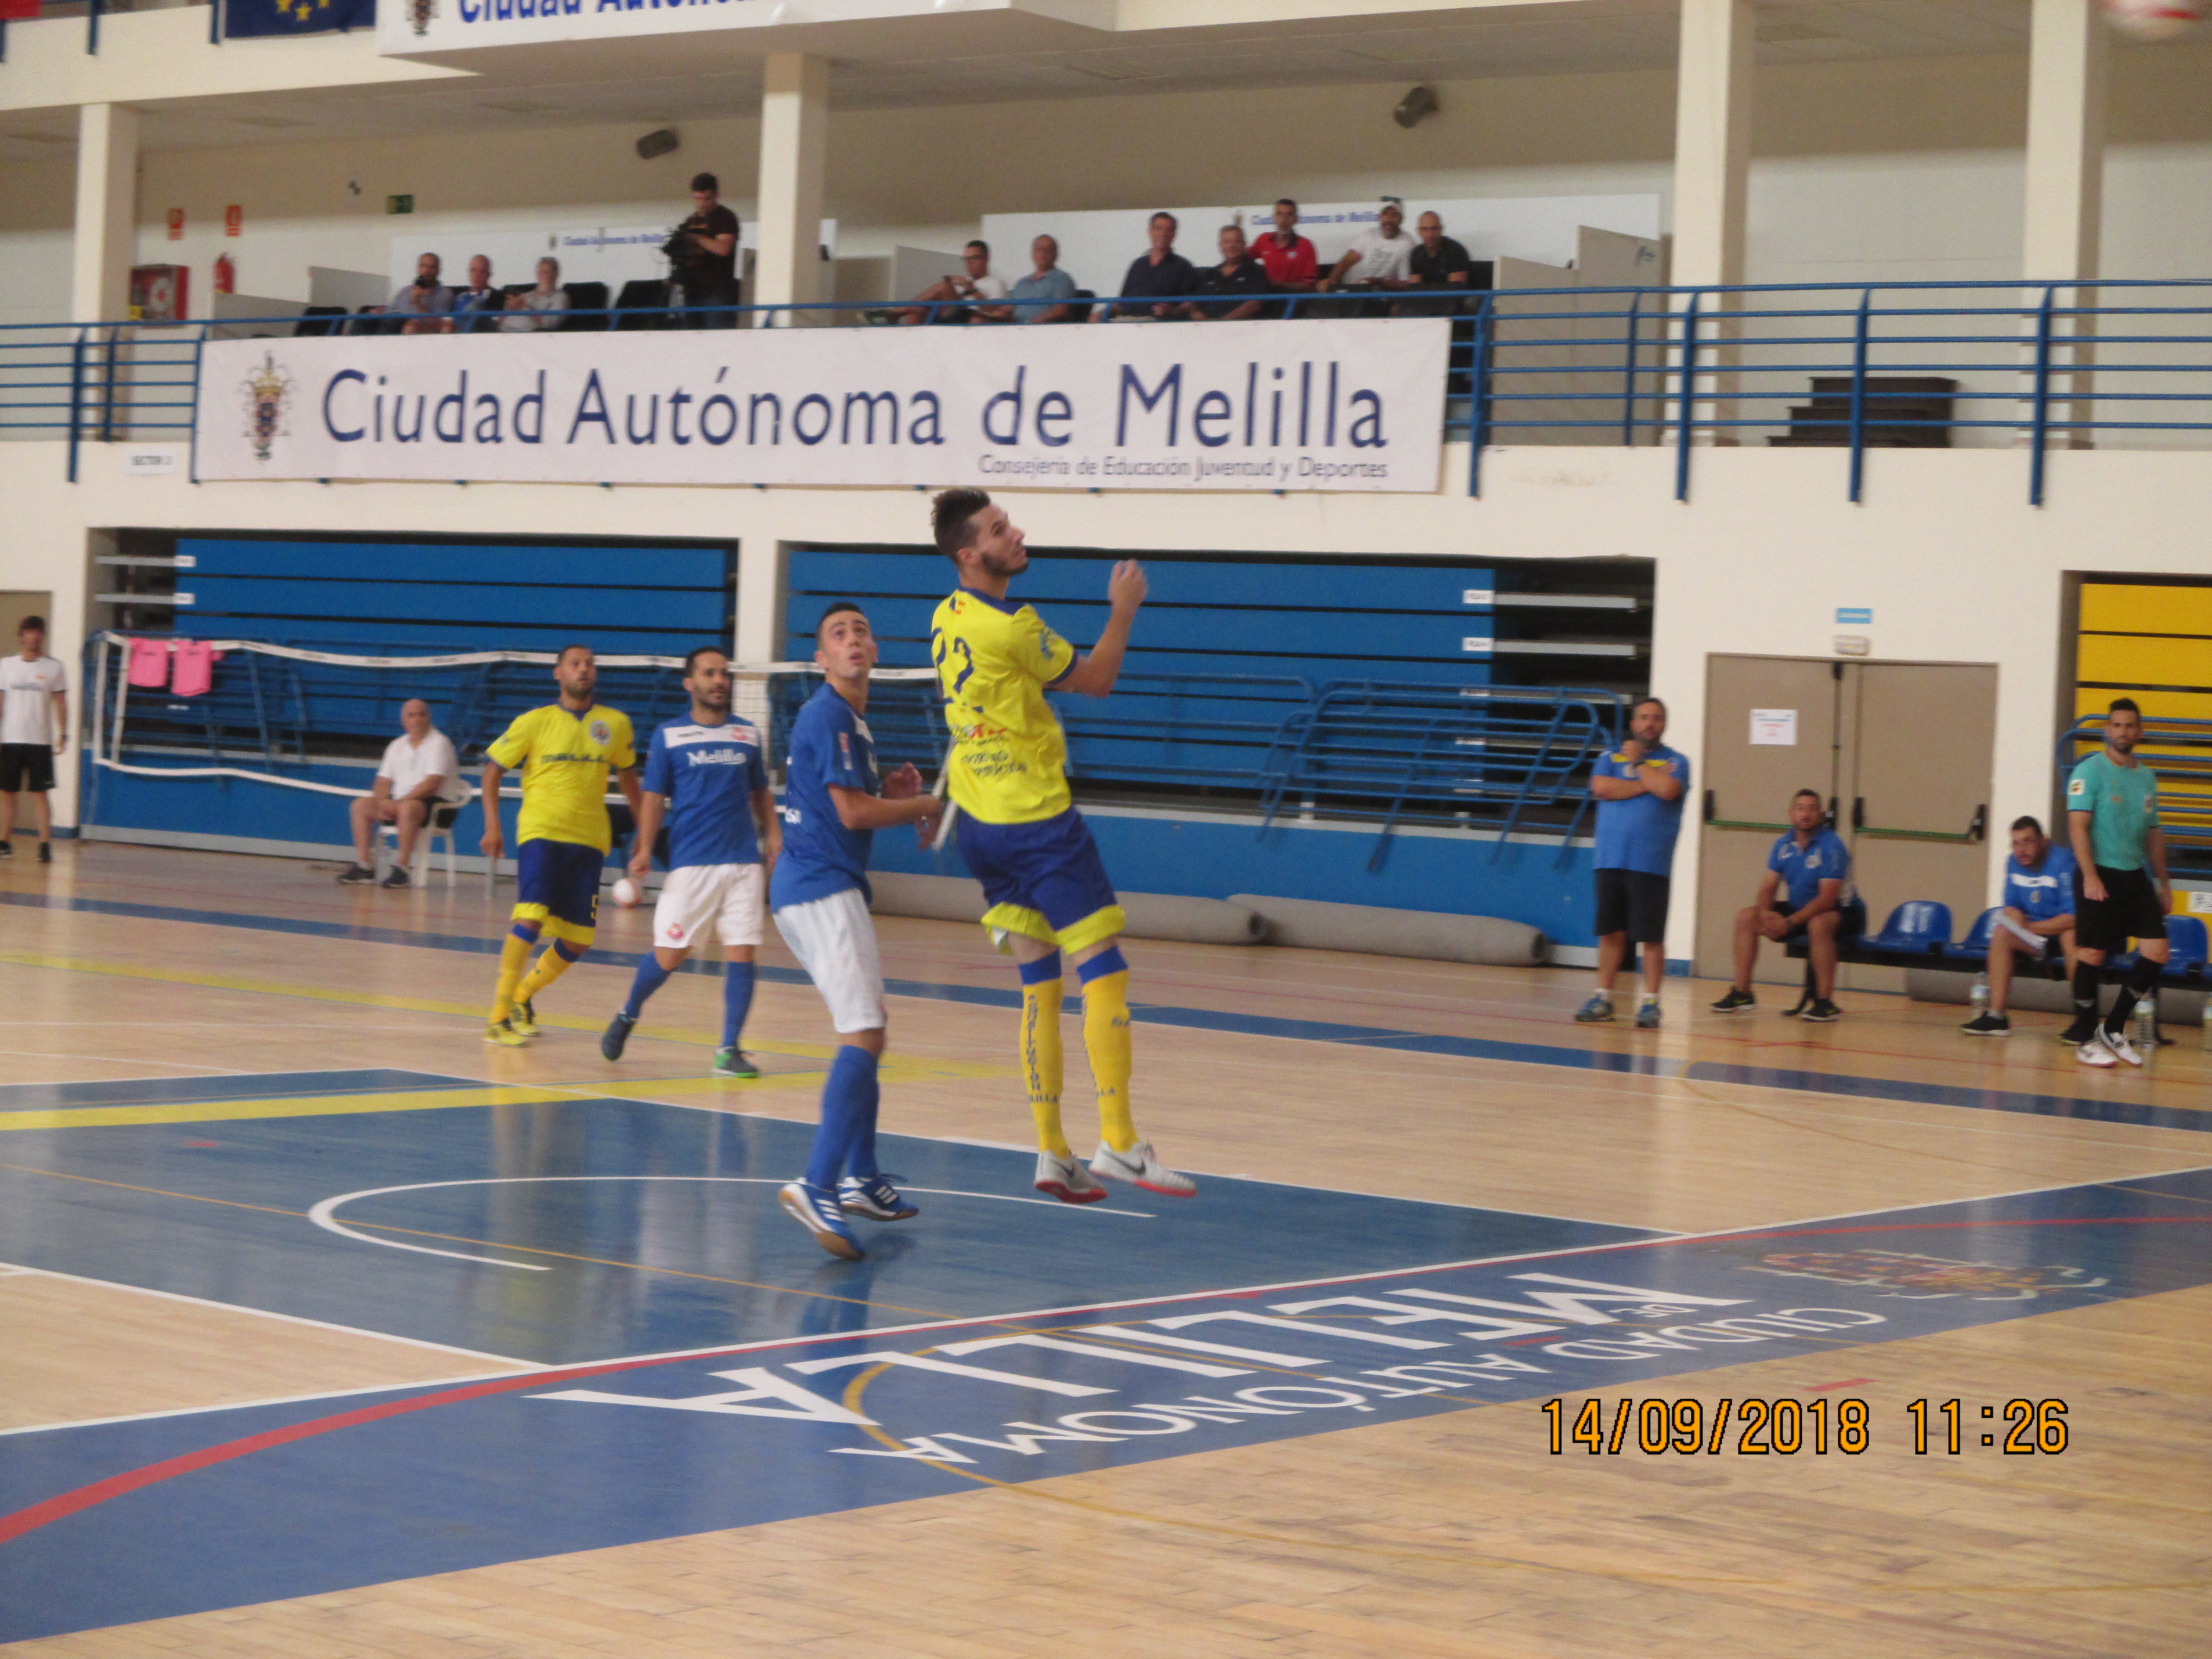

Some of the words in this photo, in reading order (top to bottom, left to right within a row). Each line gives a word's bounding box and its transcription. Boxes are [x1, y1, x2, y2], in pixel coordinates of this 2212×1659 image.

[322, 369, 546, 443] Ciudad
[565, 366, 946, 445] Autónoma
[981, 365, 1073, 446] de
[1115, 361, 1388, 448] Melilla
[978, 454, 1071, 479] Consejería
[1076, 456, 1097, 475] de
[1104, 456, 1191, 476] Educación
[1193, 456, 1275, 481] Juventud
[1279, 462, 1293, 482] y
[1298, 456, 1388, 482] Deportes
[1542, 1307, 1888, 1361] CIUDAD
[1607, 1303, 1700, 1318] DE
[520, 1272, 1755, 1427] MELILLA
